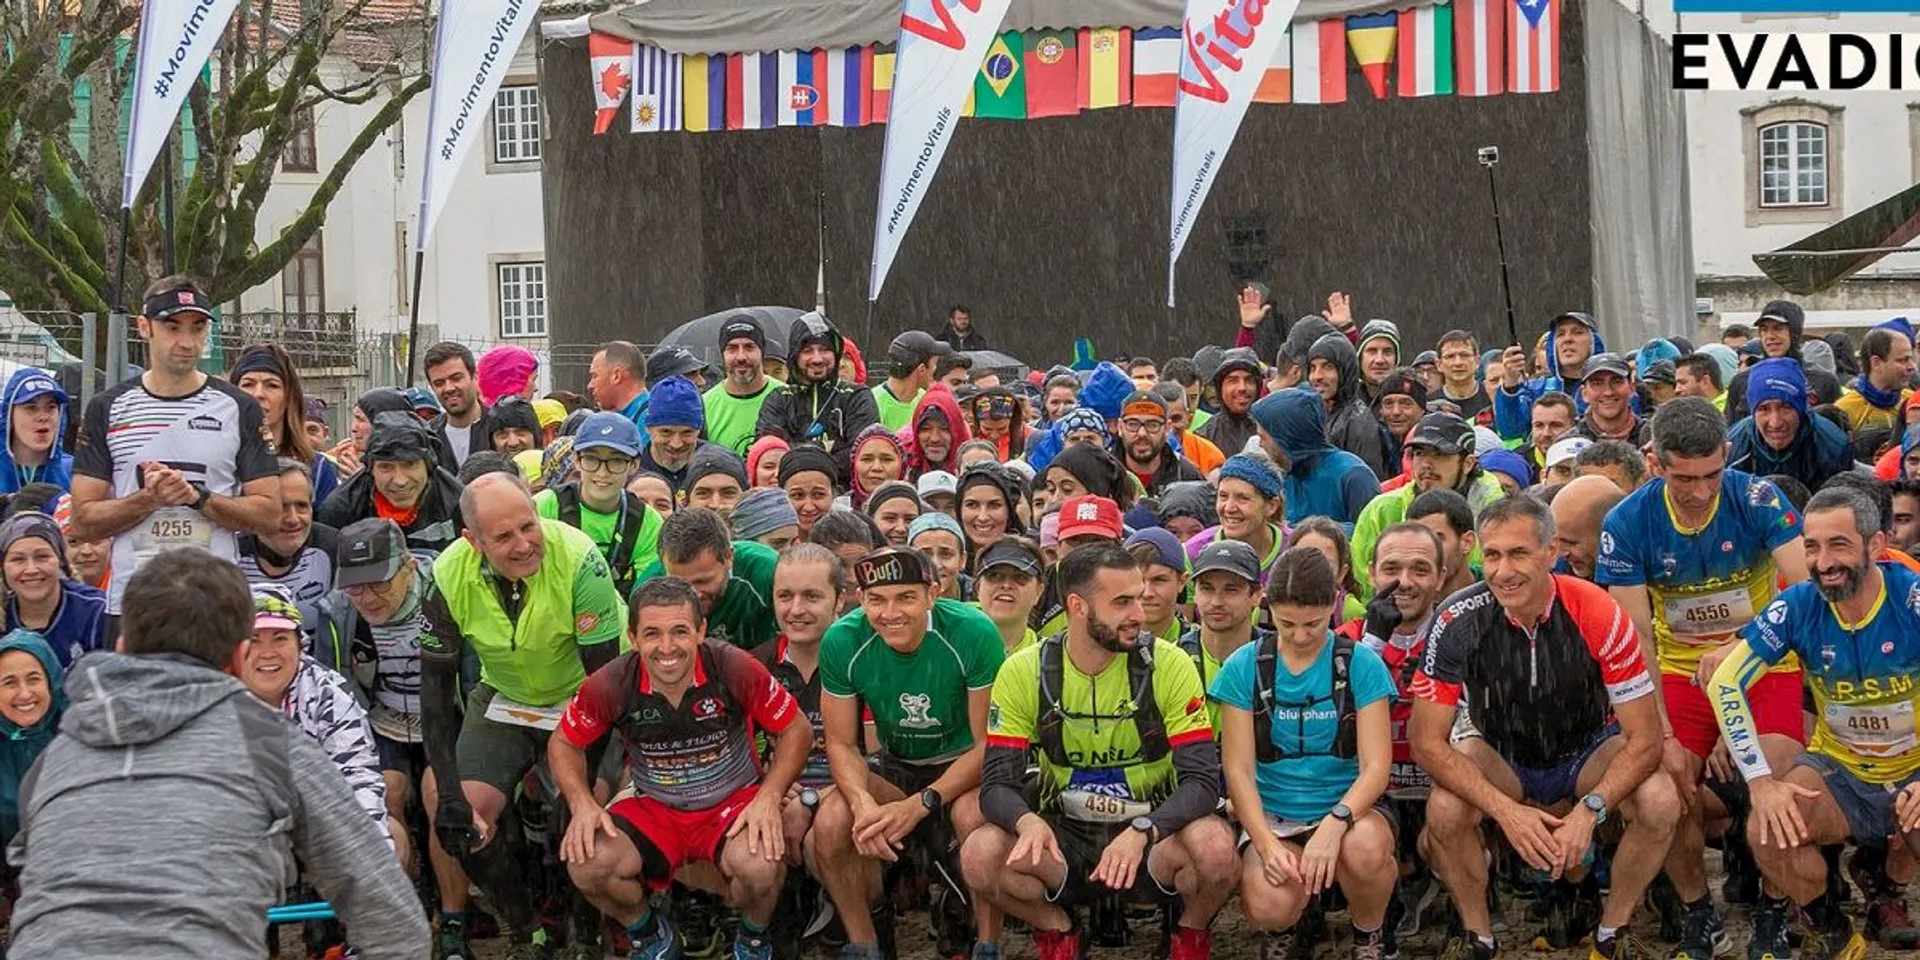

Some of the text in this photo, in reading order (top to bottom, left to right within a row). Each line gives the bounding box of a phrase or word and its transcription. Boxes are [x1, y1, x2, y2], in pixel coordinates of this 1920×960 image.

[887, 106, 951, 234] #MovimentoVitalis
[1170, 149, 1216, 251] ovimentoVitalis
[151, 519, 193, 537] 4255
[1686, 603, 1730, 622] 4556
[1848, 716, 1890, 730] 4481
[1085, 795, 1127, 815] 4361
